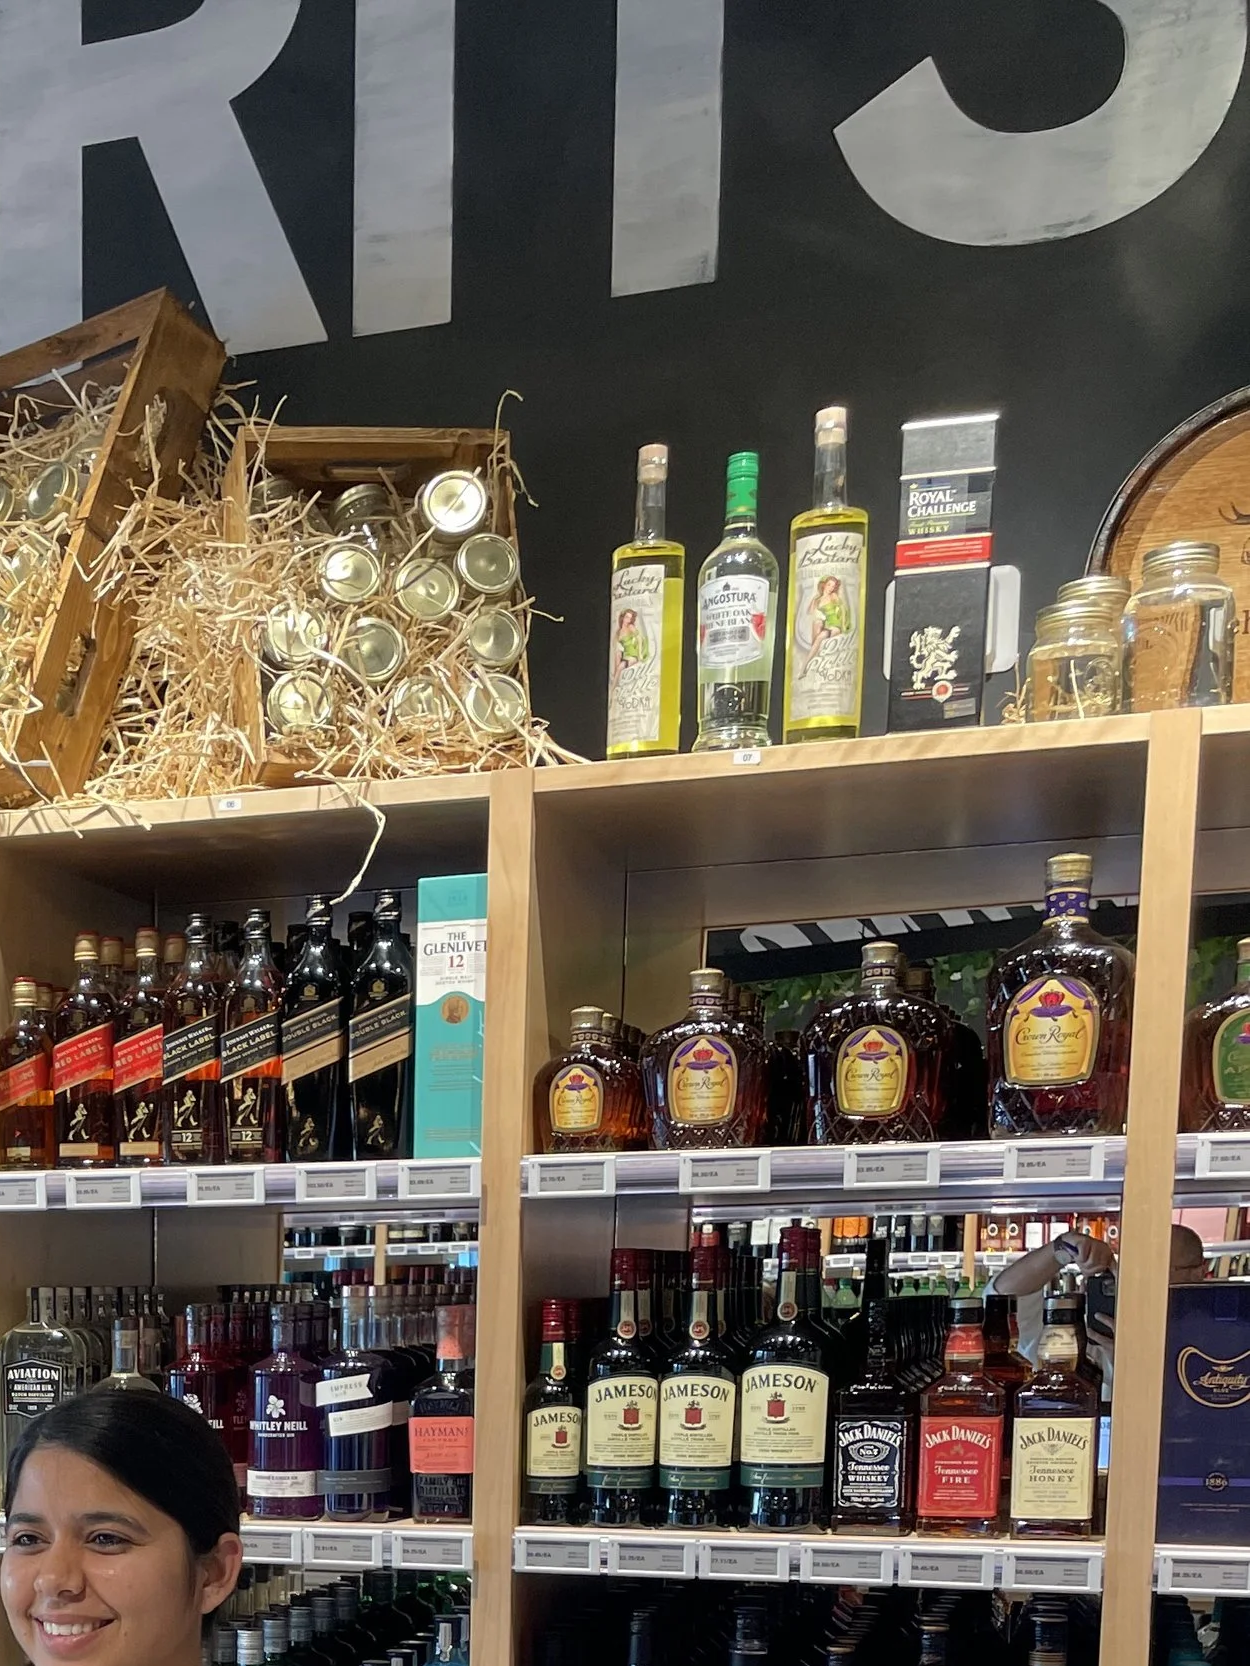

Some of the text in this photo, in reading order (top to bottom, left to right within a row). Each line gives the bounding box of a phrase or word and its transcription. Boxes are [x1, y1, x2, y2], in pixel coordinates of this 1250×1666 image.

[909, 489, 954, 506] ROYAL
[907, 501, 977, 518] CHALLENGE
[908, 524, 950, 535] WHISKY
[812, 534, 862, 553] Lucky
[799, 550, 861, 568] Bastard
[613, 582, 659, 600] astard
[701, 592, 758, 610] ANGOSTURA
[742, 753, 753, 762] 07
[448, 932, 467, 941] THE
[423, 940, 487, 956] GLENLIVET
[449, 954, 464, 969] 12
[282, 1015, 338, 1043] DOUBLE BLACK
[350, 1010, 406, 1040] DOUBLE BLACK
[222, 1041, 249, 1058] BLACK
[249, 1031, 276, 1046] LABEL
[1016, 1027, 1085, 1046] Crown Royal
[163, 1044, 188, 1060] BLACK
[188, 1034, 216, 1049] LABEL
[54, 1043, 104, 1069] RED LABEL
[114, 1055, 134, 1067] RED
[868, 1068, 898, 1082] Royal
[181, 1133, 193, 1143] 12
[241, 1131, 253, 1141] 12
[7, 1368, 59, 1381] AVIATION
[745, 1373, 816, 1393] JAMESON
[1193, 1371, 1250, 1390] Antiquity
[330, 1382, 363, 1393] EMPRESS
[663, 1384, 729, 1402] JAMESON
[250, 1420, 308, 1431] WHITLEY NEILL
[838, 1425, 904, 1447] JACK DANIEL'S
[925, 1425, 993, 1450] JACK DANIEL'S
[1020, 1427, 1090, 1451] JACK DANIEL'S
[847, 1462, 890, 1472] Tennessee
[934, 1466, 979, 1475] Tennessee
[1028, 1465, 1075, 1475] Tennessee
[941, 1475, 971, 1483] FIRE
[1028, 1475, 1075, 1483] HONEY
